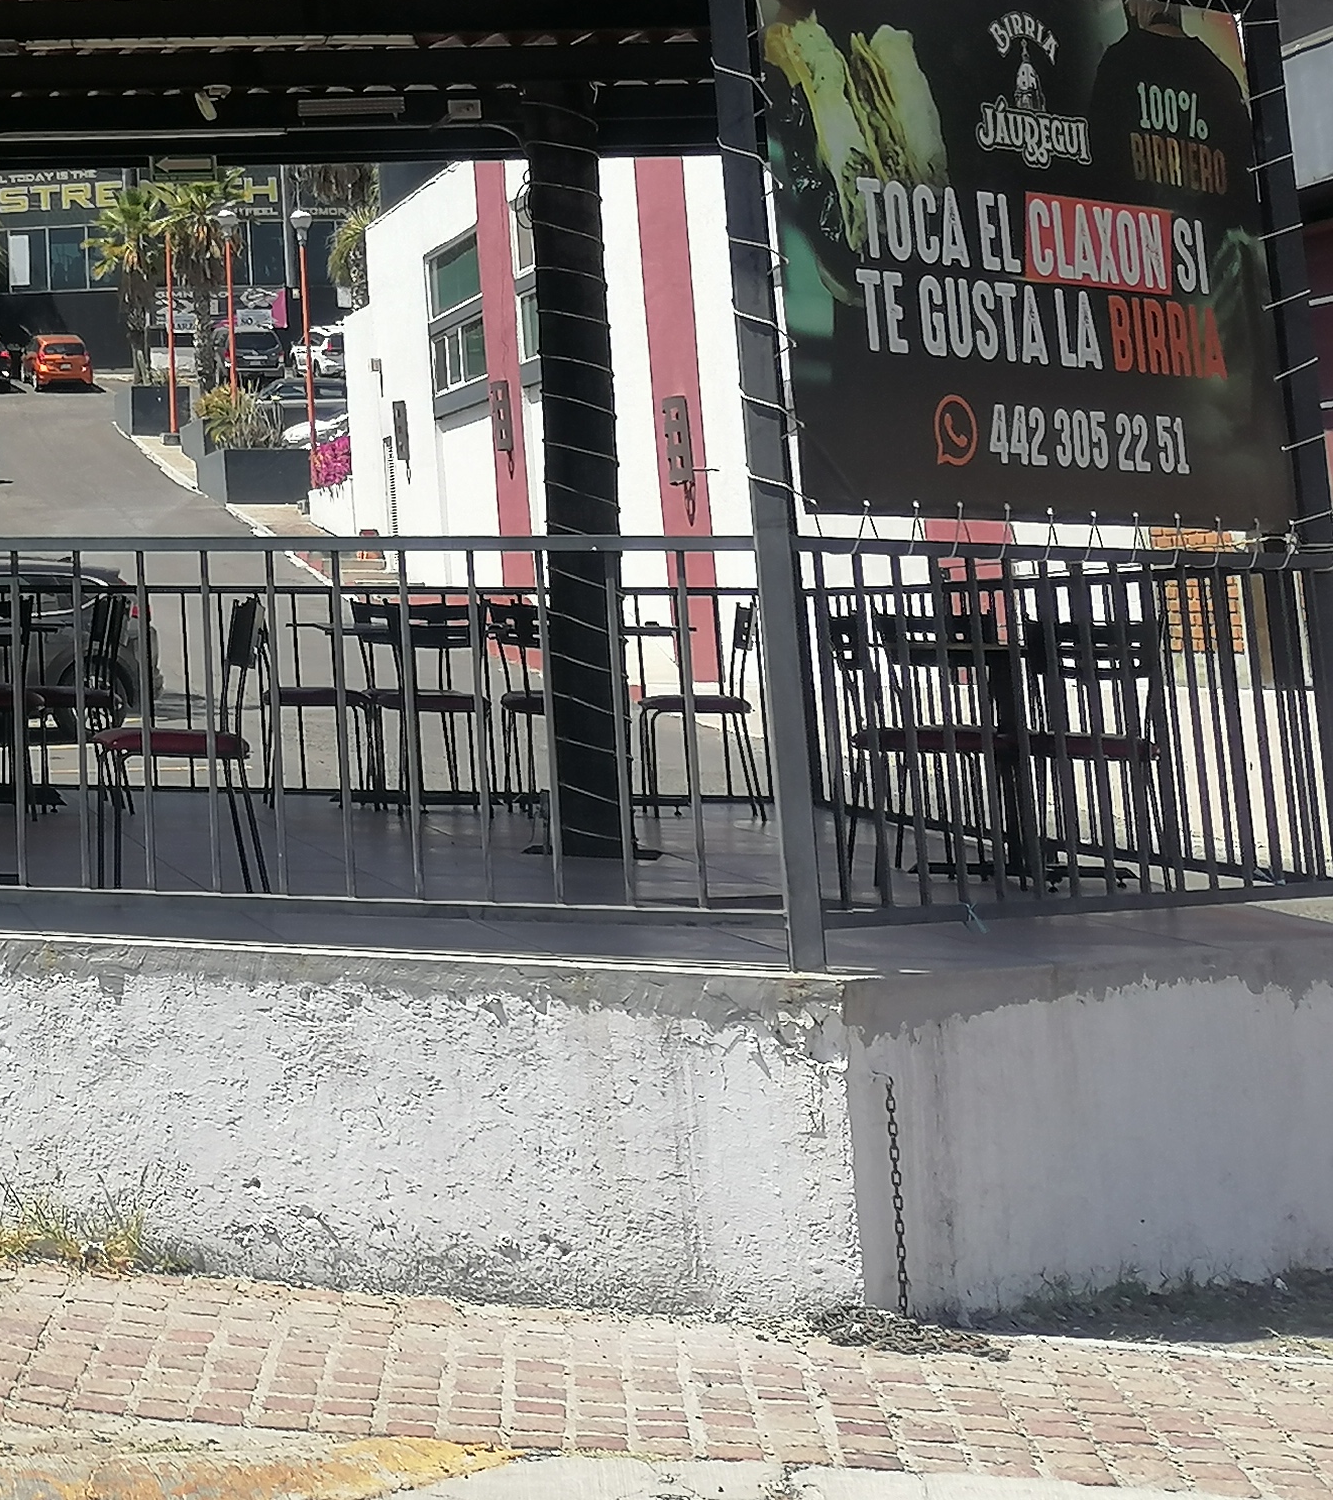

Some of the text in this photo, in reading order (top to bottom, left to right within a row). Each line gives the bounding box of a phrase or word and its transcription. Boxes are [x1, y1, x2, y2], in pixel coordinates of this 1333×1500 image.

[987, 11, 1061, 66] BIRRIA
[977, 96, 1093, 167] JÁUREGUI
[1136, 80, 1210, 141] 100%
[1130, 133, 1228, 196] BIRRIERO
[856, 176, 1210, 296] TOCA EL CLAXON SI
[856, 268, 1228, 380] TE GUSTA LA BIRRIA
[989, 402, 1191, 475] 442 305 22 51
